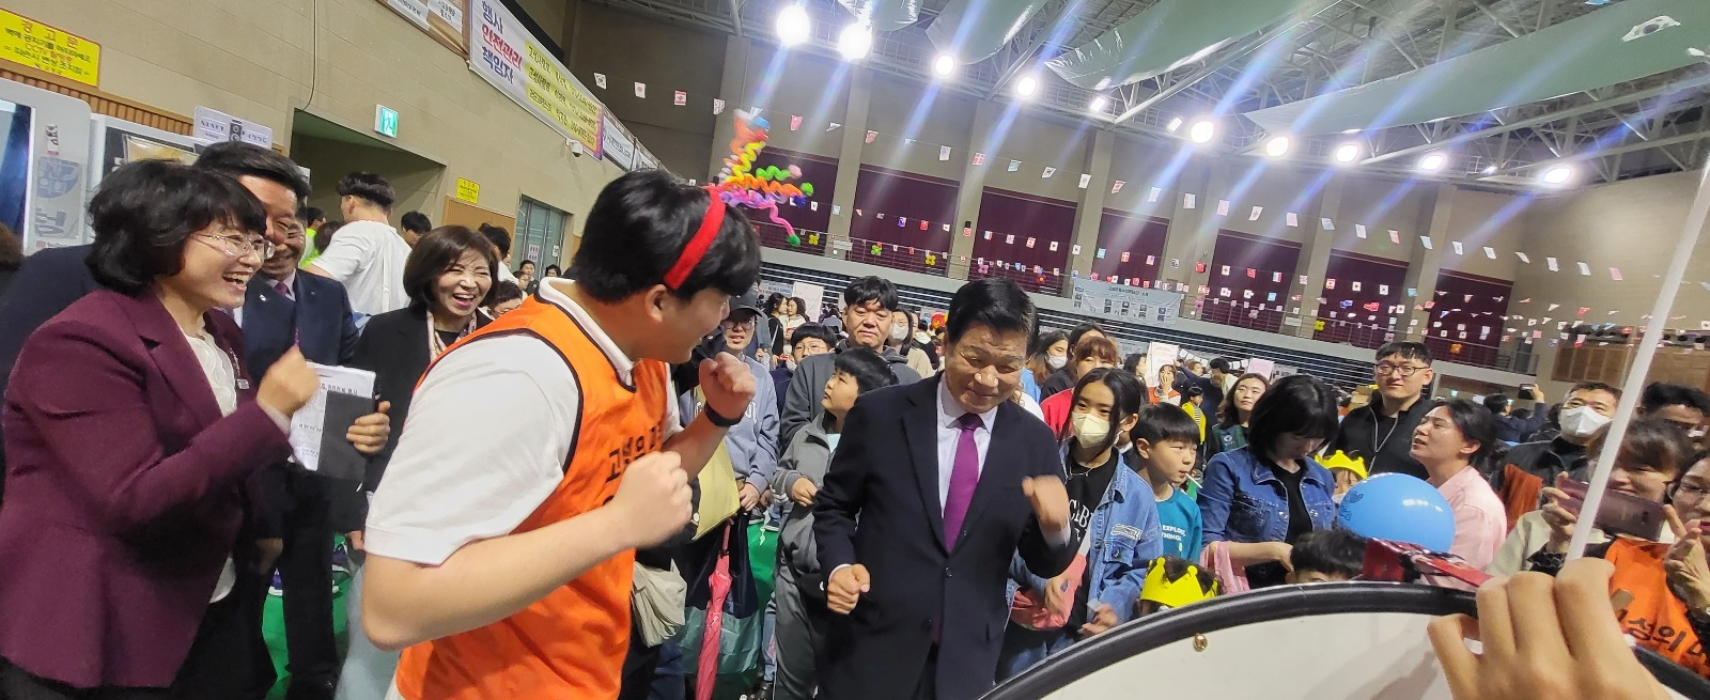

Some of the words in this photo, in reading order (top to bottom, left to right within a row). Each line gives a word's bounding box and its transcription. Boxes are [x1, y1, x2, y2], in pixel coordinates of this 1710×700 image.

[481, 1, 503, 34] 행사
[481, 24, 523, 70] 안전관리
[481, 46, 514, 84] 책임자
